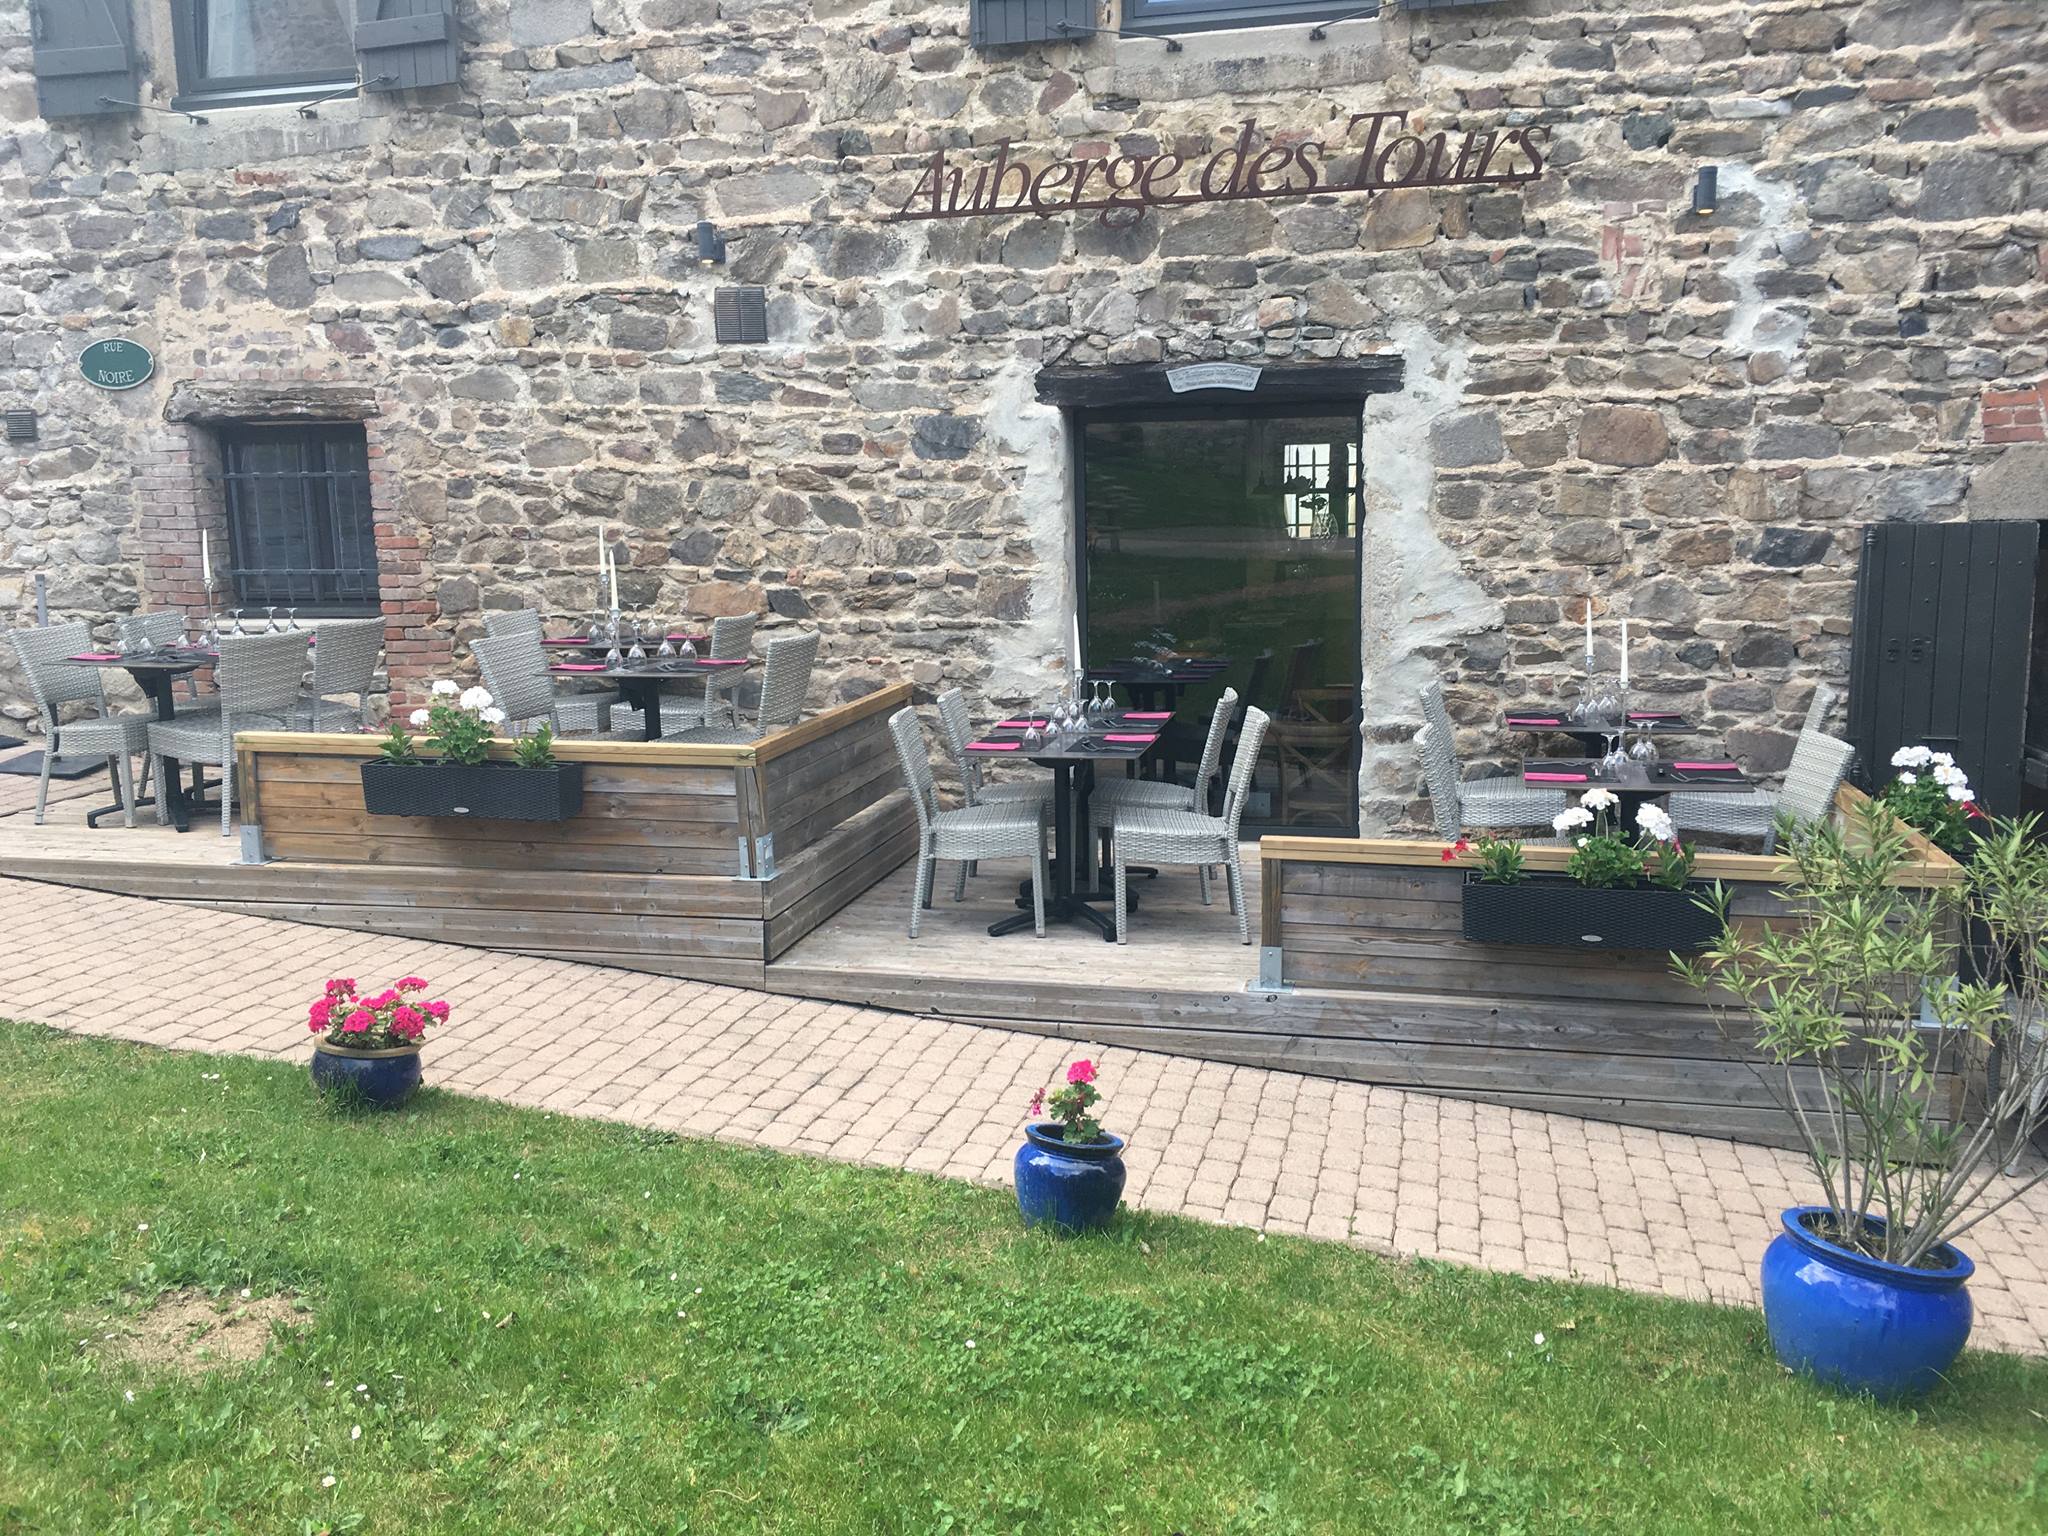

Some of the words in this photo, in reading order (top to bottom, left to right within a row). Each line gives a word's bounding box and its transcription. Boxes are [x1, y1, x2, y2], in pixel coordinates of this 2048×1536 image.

[900, 136, 1184, 229] Auberge
[1200, 117, 1325, 199] des
[1347, 110, 1551, 188] Tours
[103, 342, 124, 352] RUE
[98, 370, 134, 383] NOIRE
